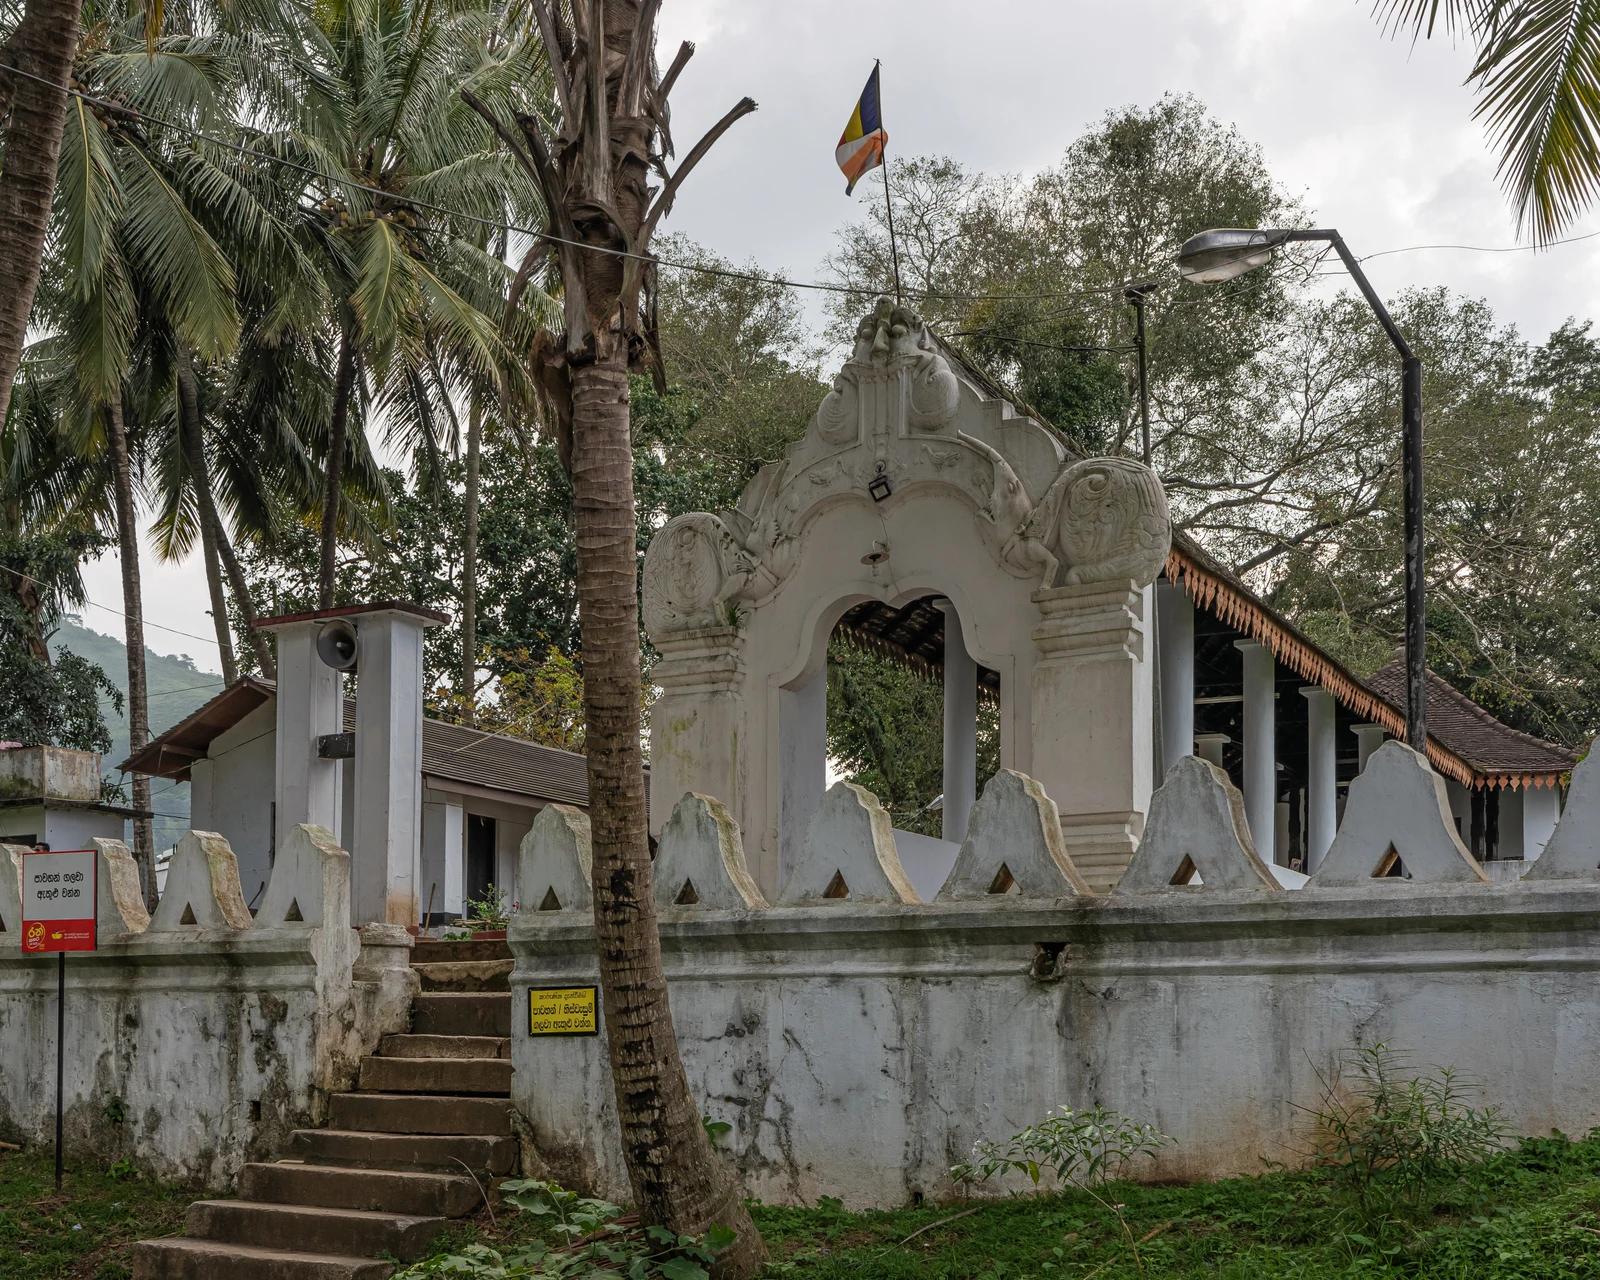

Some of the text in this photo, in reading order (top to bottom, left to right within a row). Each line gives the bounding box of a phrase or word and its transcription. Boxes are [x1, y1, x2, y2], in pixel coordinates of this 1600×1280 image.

[34, 871, 84, 883] පාවහන් ගලවා
[61, 887, 80, 898] වන්න
[533, 1003, 557, 1016] පාවහන්
[534, 1019, 552, 1031] ගලවා
